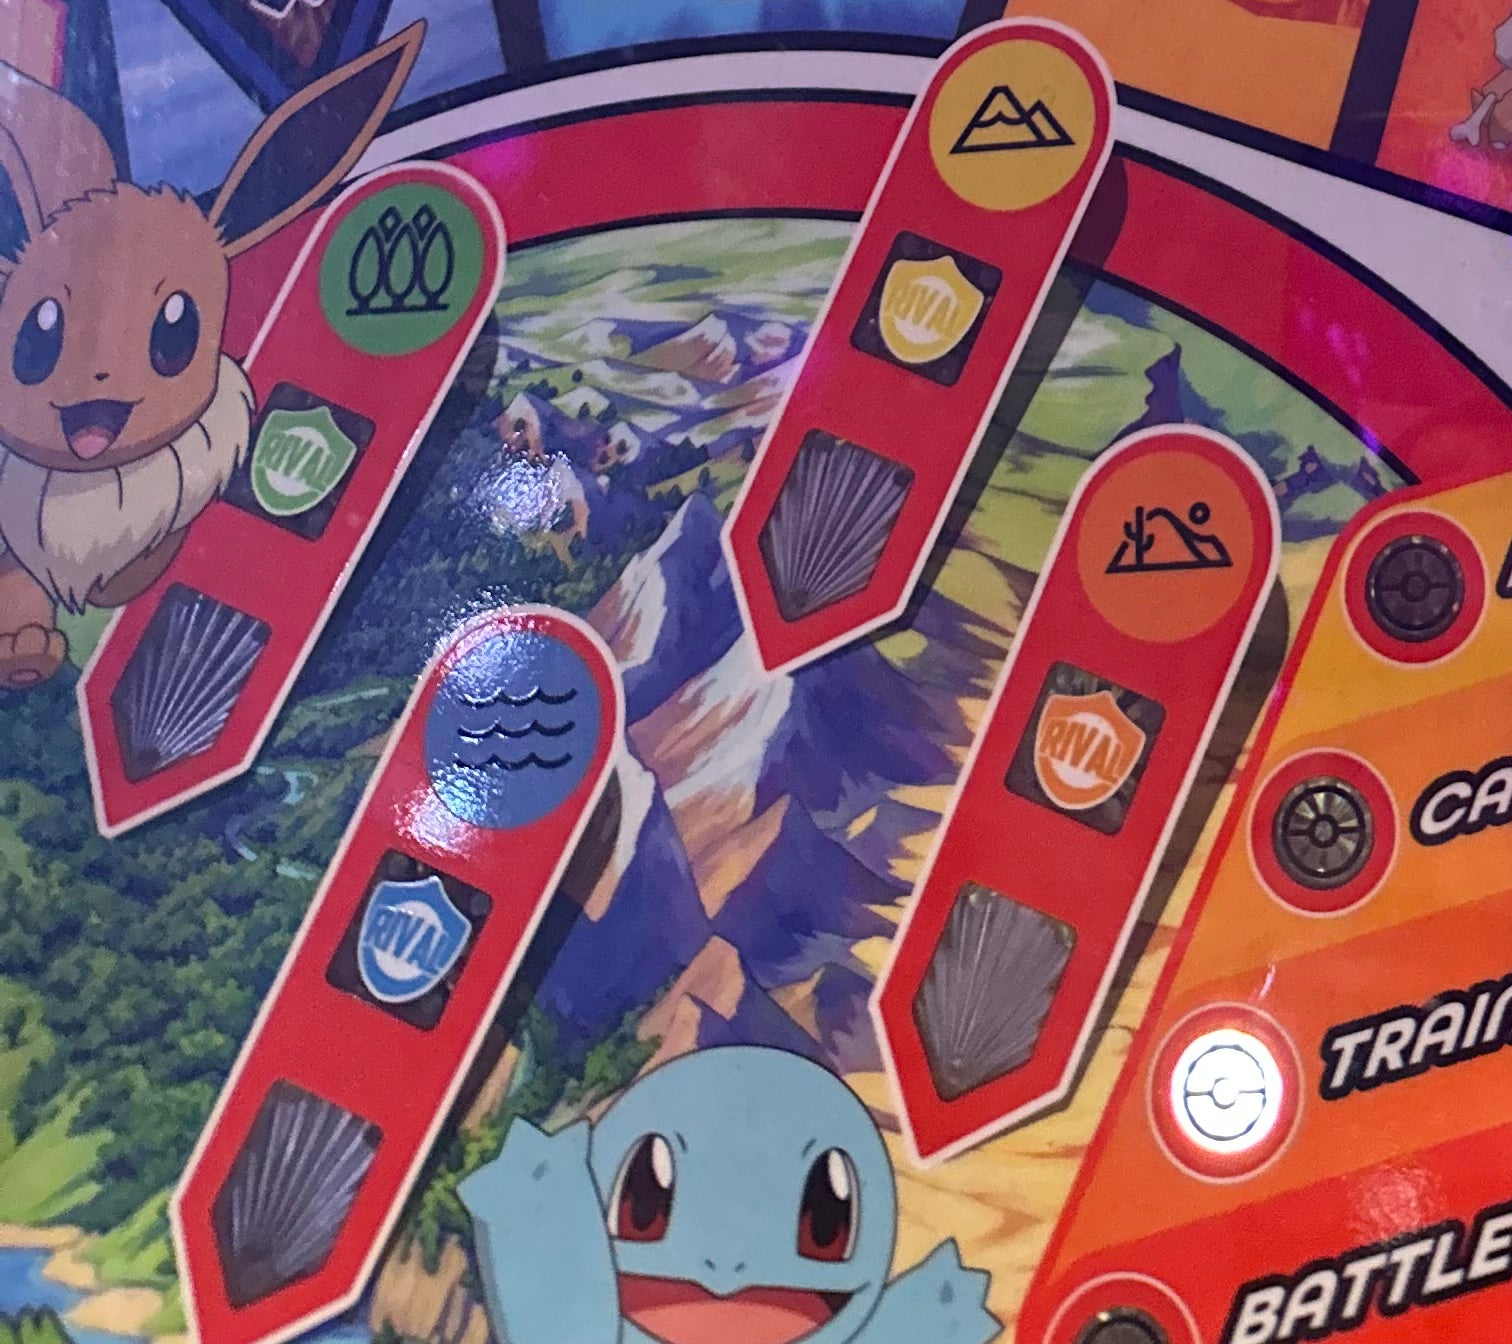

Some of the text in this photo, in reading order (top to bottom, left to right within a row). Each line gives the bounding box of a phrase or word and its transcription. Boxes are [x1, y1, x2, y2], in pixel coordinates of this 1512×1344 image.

[882, 278, 965, 340] RIVAL
[256, 429, 337, 493] RIVAL
[1039, 716, 1123, 786] RIVAL
[362, 907, 449, 976] RIVAL
